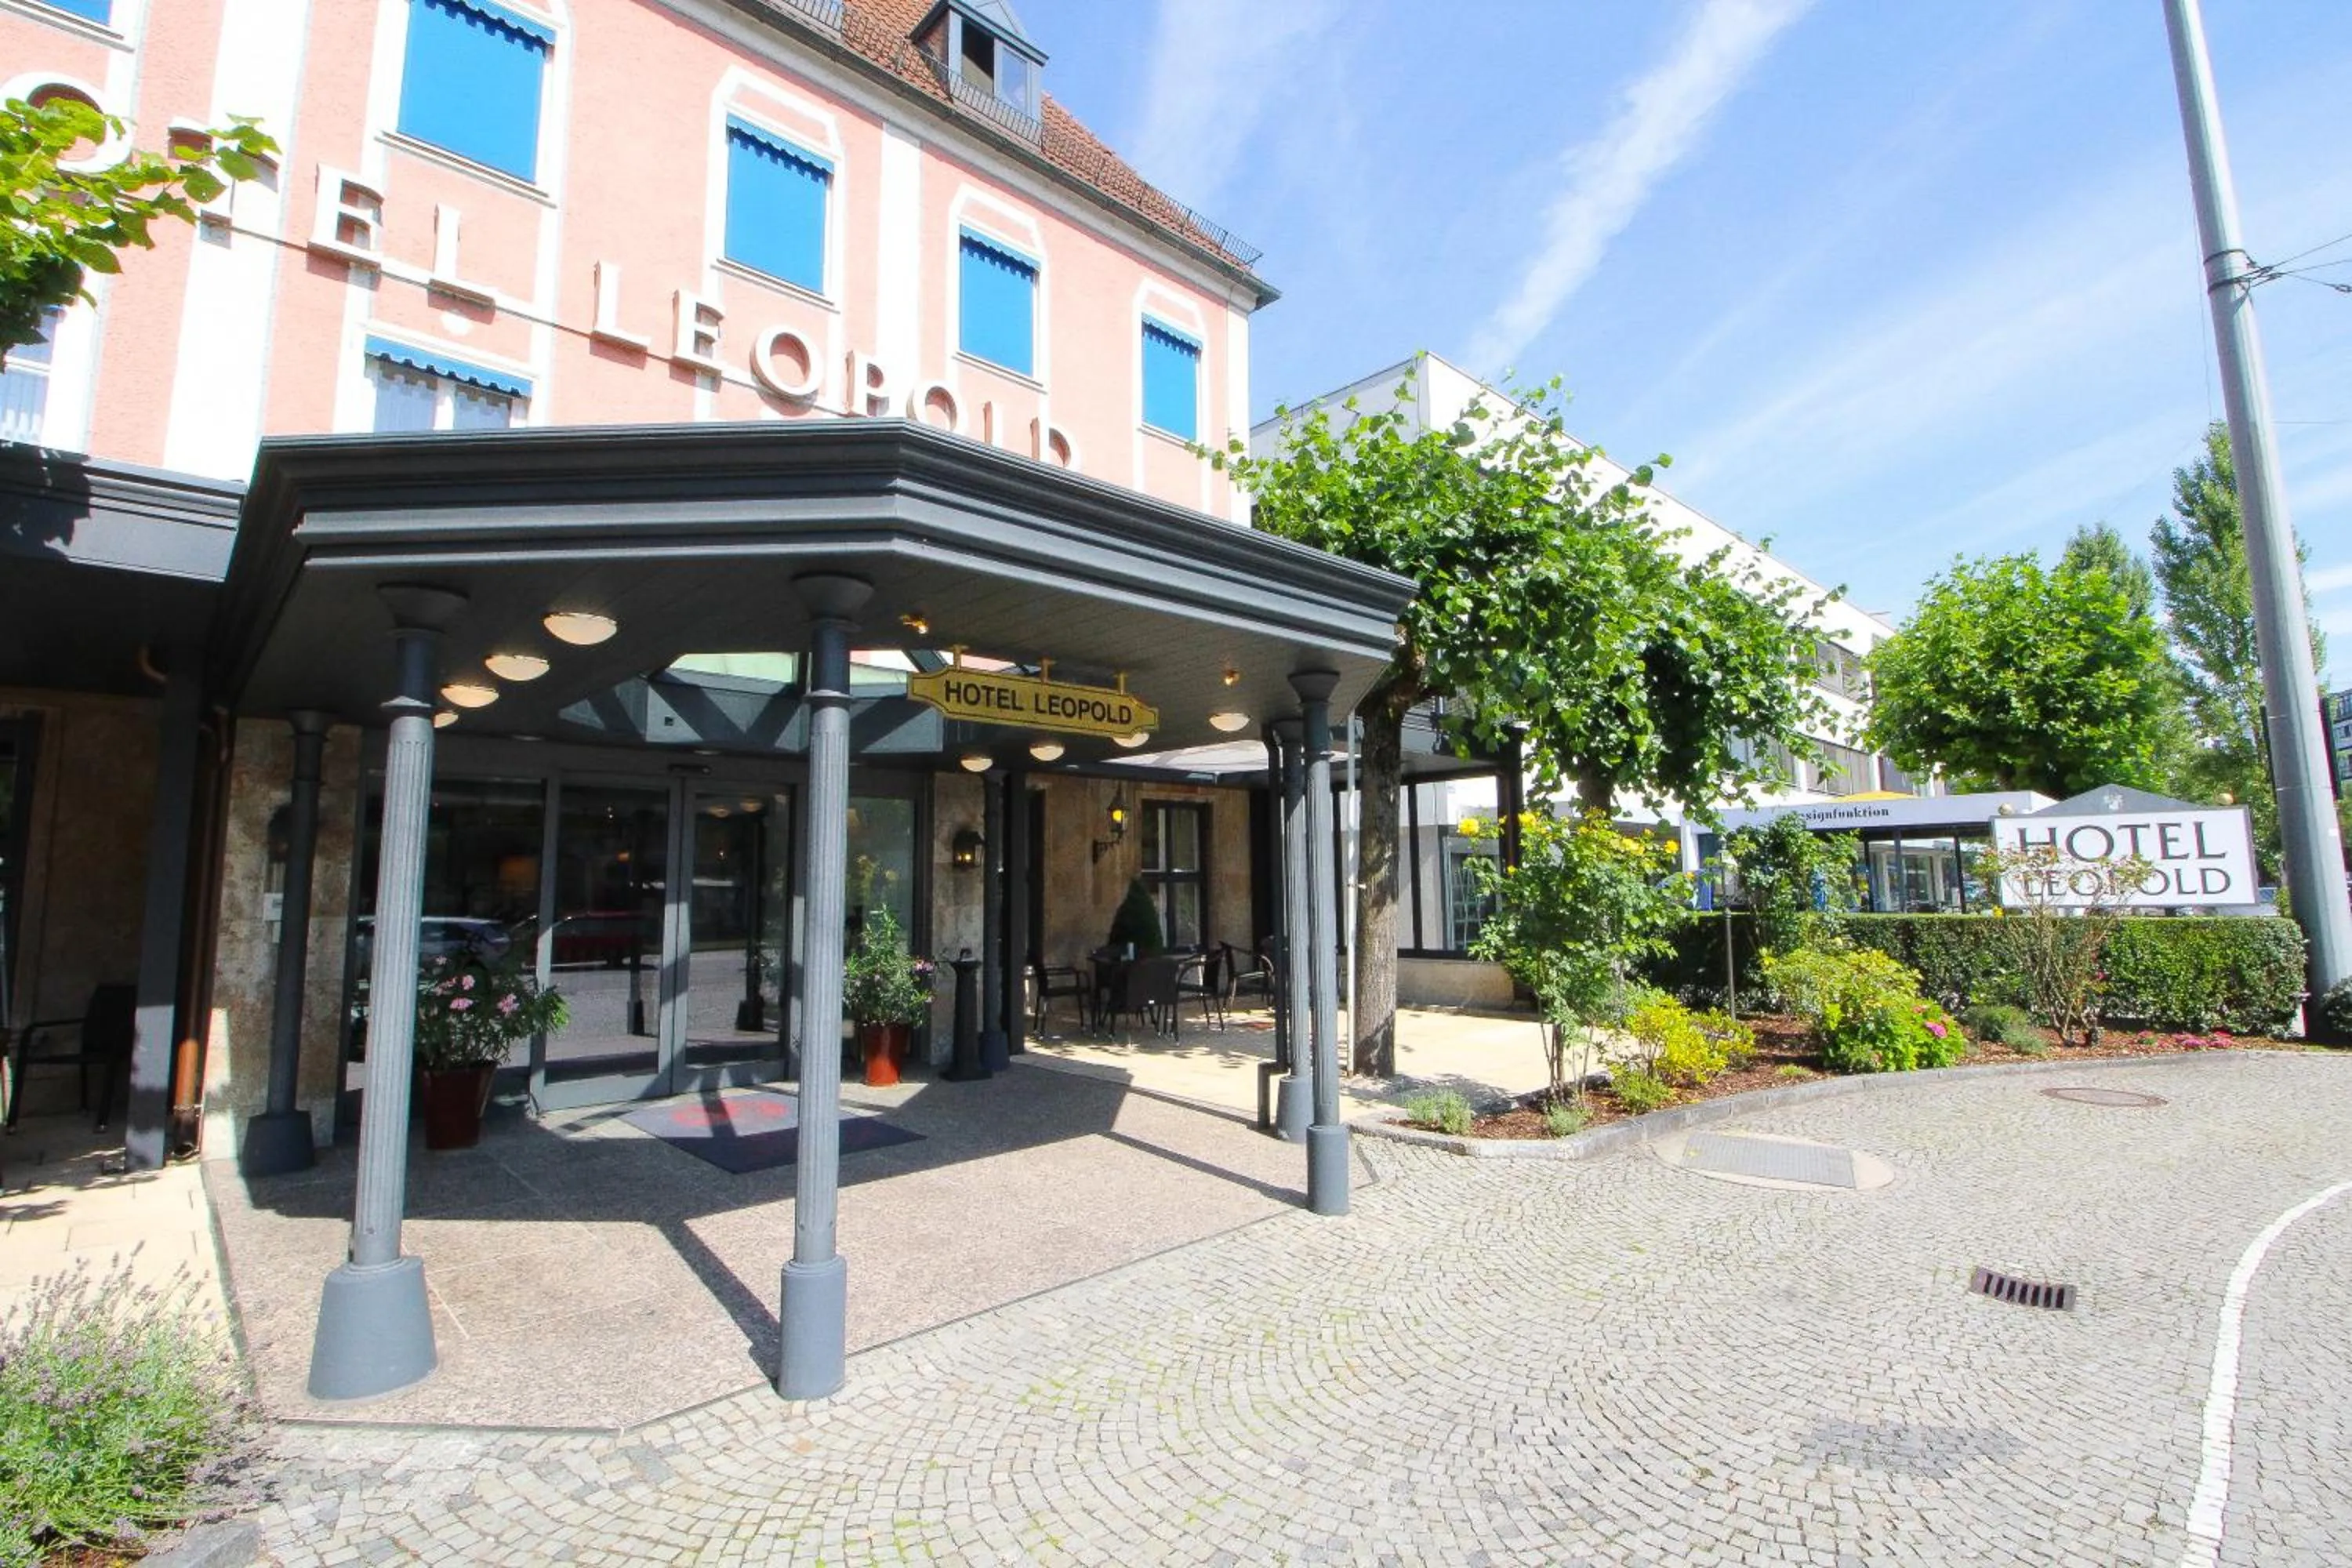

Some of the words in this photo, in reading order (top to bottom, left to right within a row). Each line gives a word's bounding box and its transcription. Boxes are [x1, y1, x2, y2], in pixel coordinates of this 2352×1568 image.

[591, 261, 1081, 469] LEOPOLD
[945, 680, 1025, 711] HOTEL
[1034, 694, 1132, 724] LEOPOLD
[2017, 821, 2227, 862] HOTEL
